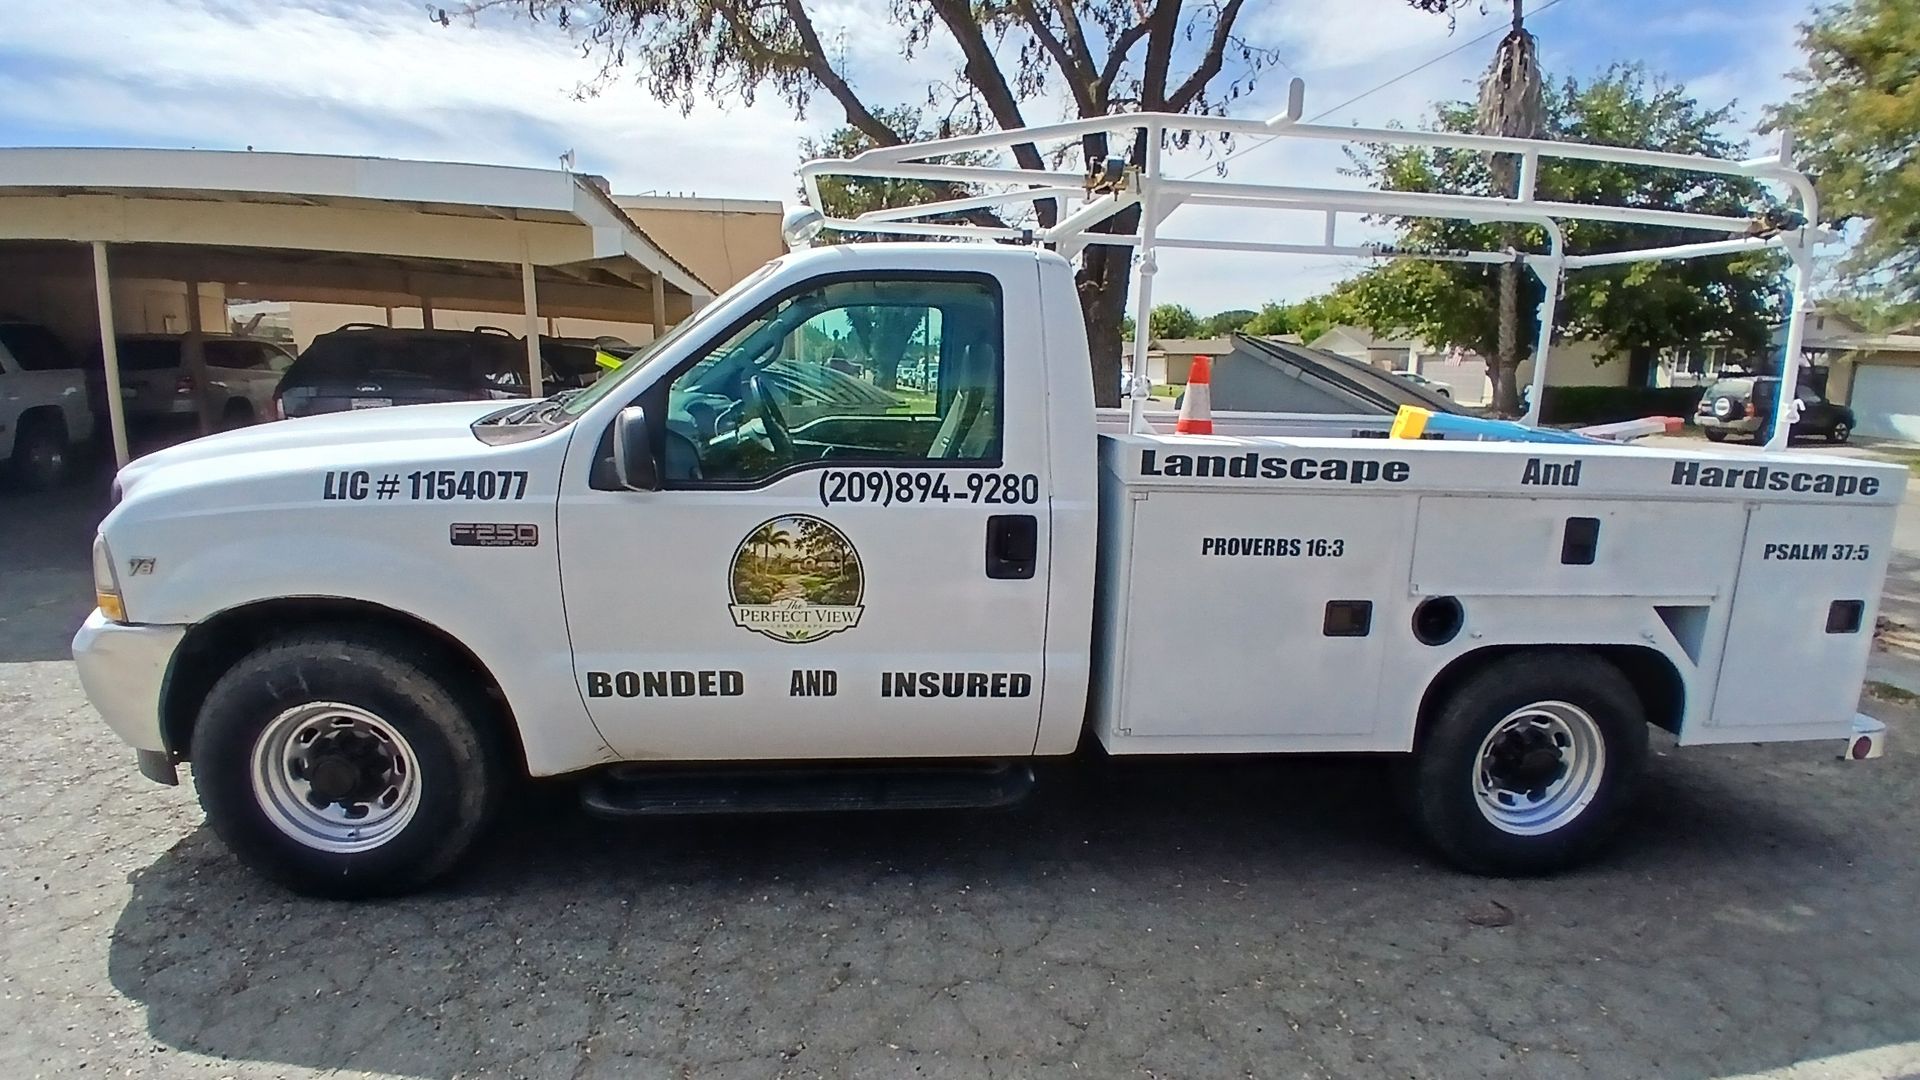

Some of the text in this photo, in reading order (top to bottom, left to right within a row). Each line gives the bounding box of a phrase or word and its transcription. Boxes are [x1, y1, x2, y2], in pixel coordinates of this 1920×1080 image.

[1141, 449, 1880, 497] Landscape And Hardscape
[324, 470, 529, 501] LIC # 1154077
[819, 470, 1039, 508] (209)894-9280
[1202, 537, 1345, 557] PROVERBS 16:3
[1763, 543, 1870, 561] PSALM 37:5
[740, 608, 856, 623] PERFECT VIEW
[786, 600, 803, 610] The
[587, 669, 1032, 698] BONDED AND INSURED
